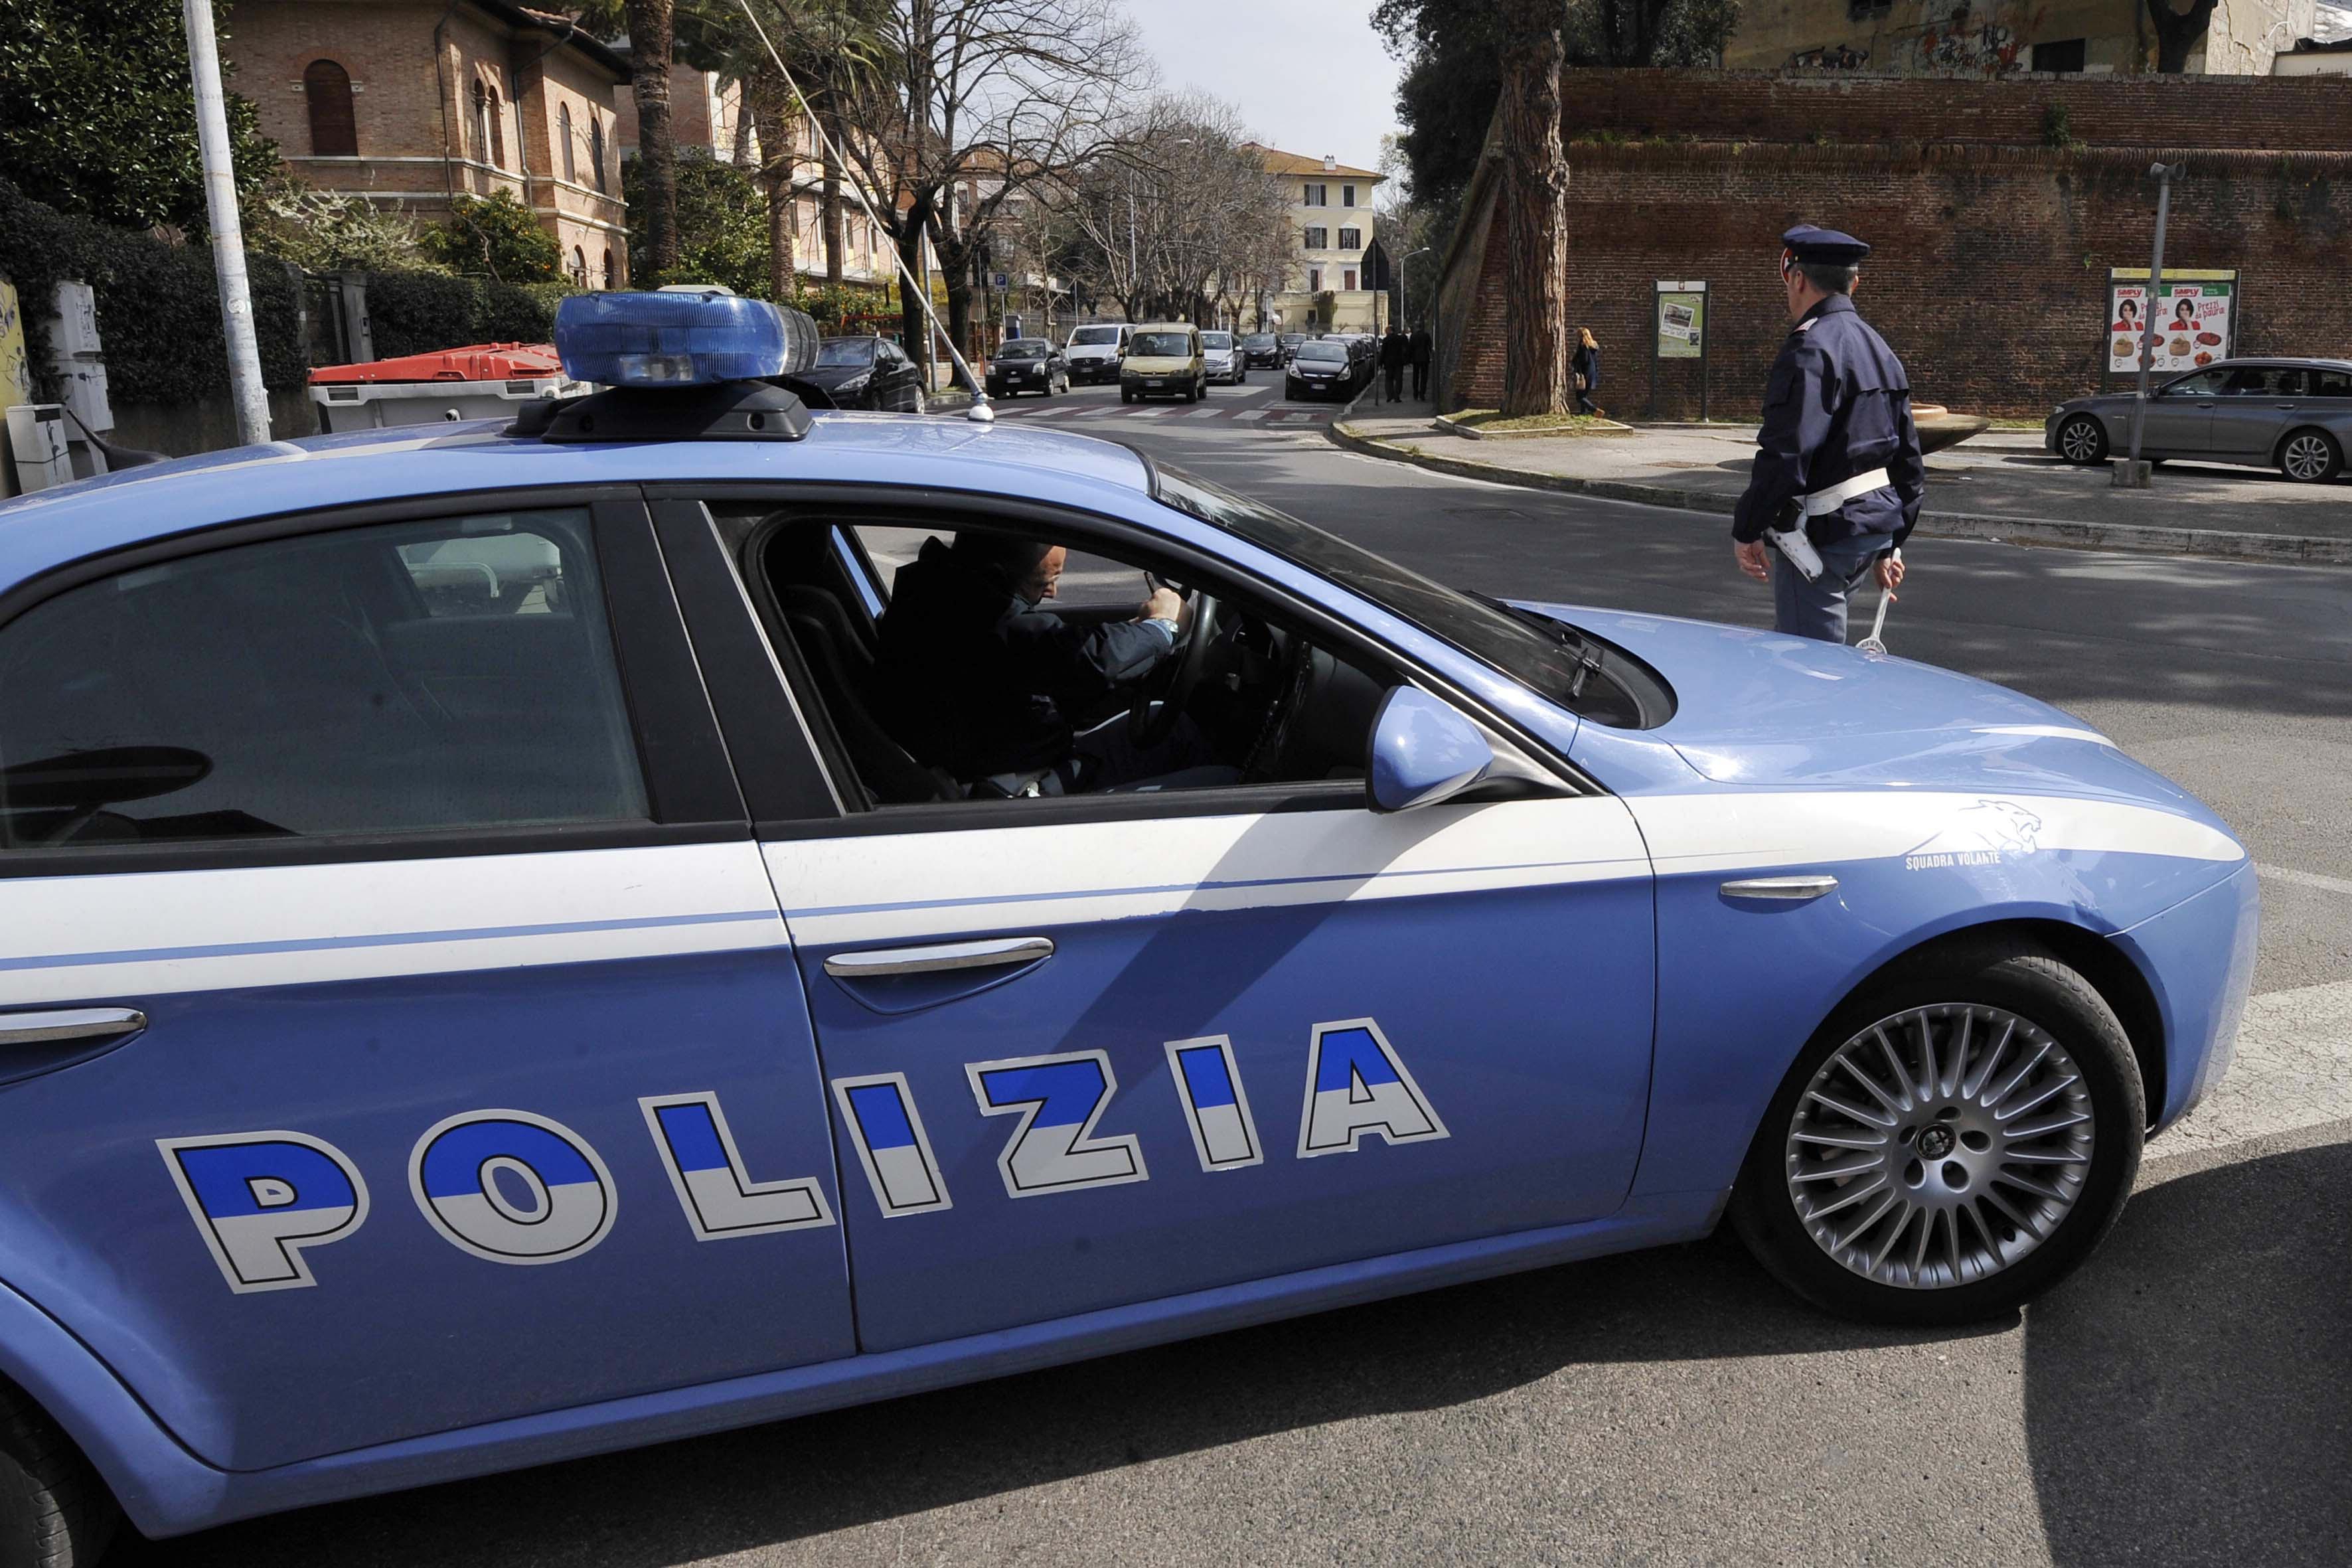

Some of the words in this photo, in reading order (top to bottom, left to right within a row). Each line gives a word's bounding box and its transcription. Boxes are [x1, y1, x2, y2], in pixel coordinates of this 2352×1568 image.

[997, 275, 1004, 285] P
[1906, 854, 1954, 871] SQUADRA
[1957, 851, 2001, 866] VOLANTE
[155, 1017, 1450, 1294] POLIZIA
